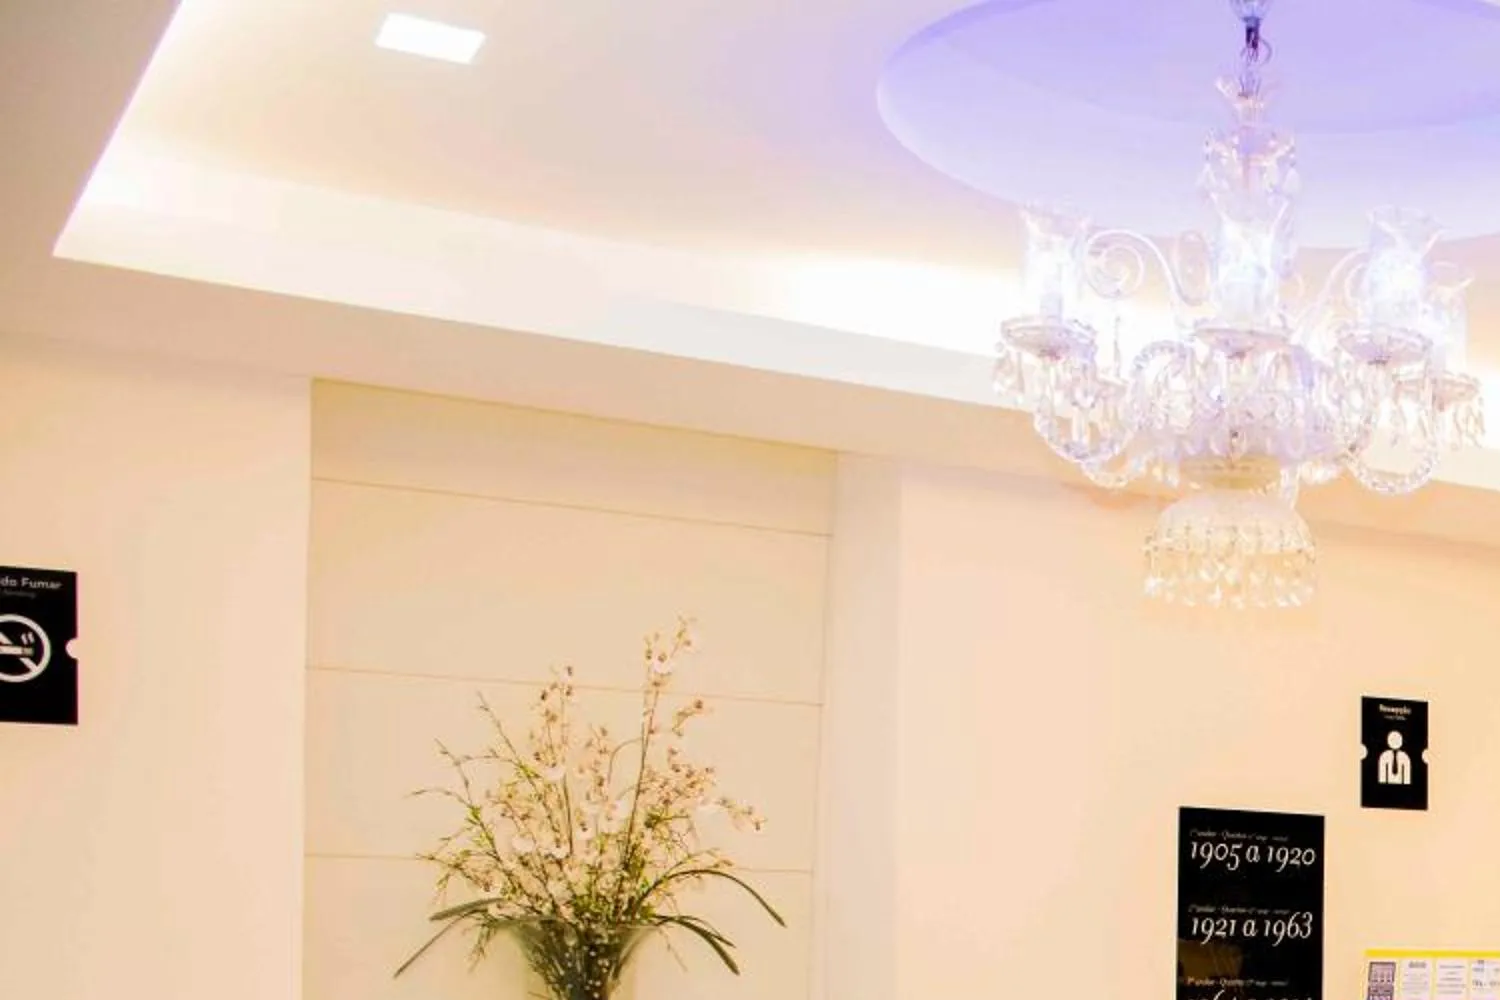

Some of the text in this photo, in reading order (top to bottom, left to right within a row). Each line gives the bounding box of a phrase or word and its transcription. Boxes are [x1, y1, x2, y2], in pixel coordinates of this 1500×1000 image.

[21, 576, 62, 589] Fumar
[1191, 841, 1316, 872] 1905 a 1920
[1192, 911, 1313, 947] 1921 a 1963
